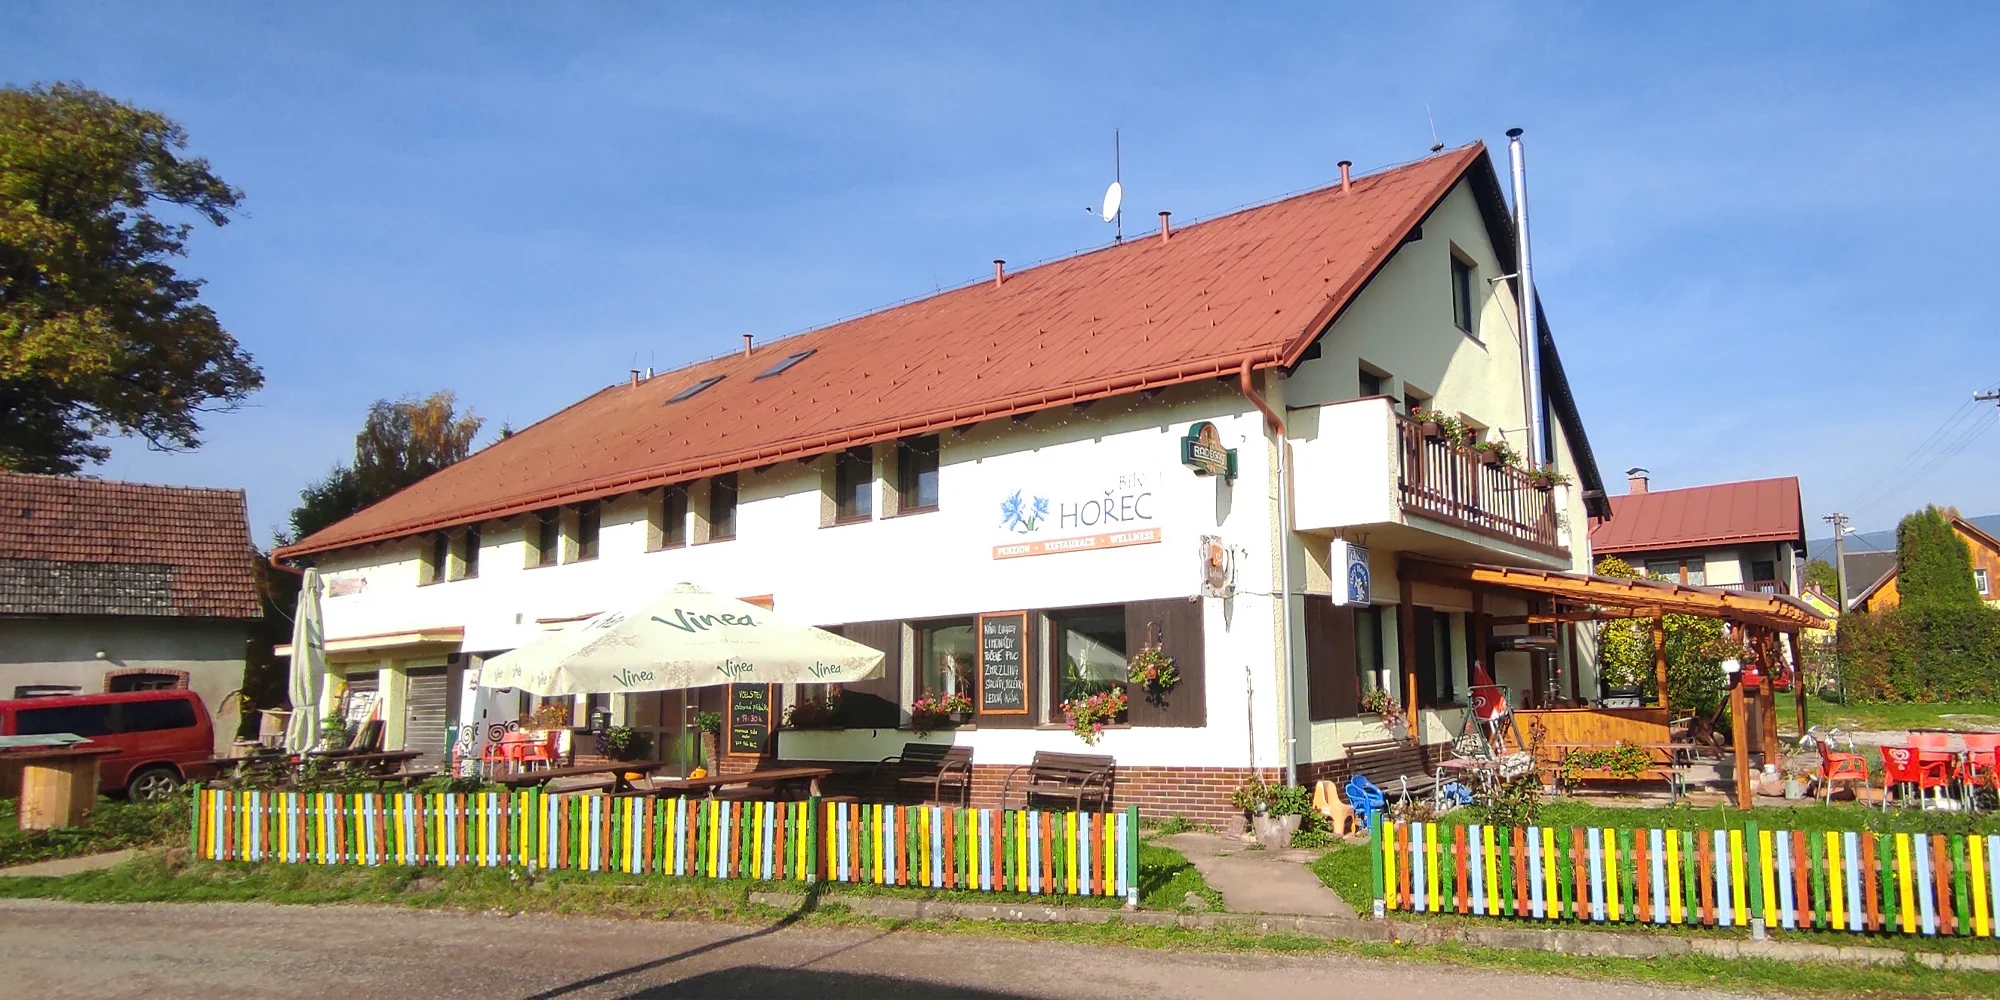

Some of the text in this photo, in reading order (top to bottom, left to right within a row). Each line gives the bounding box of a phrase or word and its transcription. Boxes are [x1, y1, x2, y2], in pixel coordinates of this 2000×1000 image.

[1060, 489, 1152, 529] HOŘEC
[1044, 537, 1096, 550] RESTAURACE
[1109, 530, 1155, 543] WELLNESS
[651, 608, 758, 633] Vinea
[984, 636, 1015, 649] LIMONÁDY
[1005, 650, 1020, 661] PIVO
[613, 668, 654, 688] Vinea
[716, 659, 754, 678] Vinea
[808, 660, 842, 679] Vinea
[984, 664, 1019, 676] ZMRZLINA
